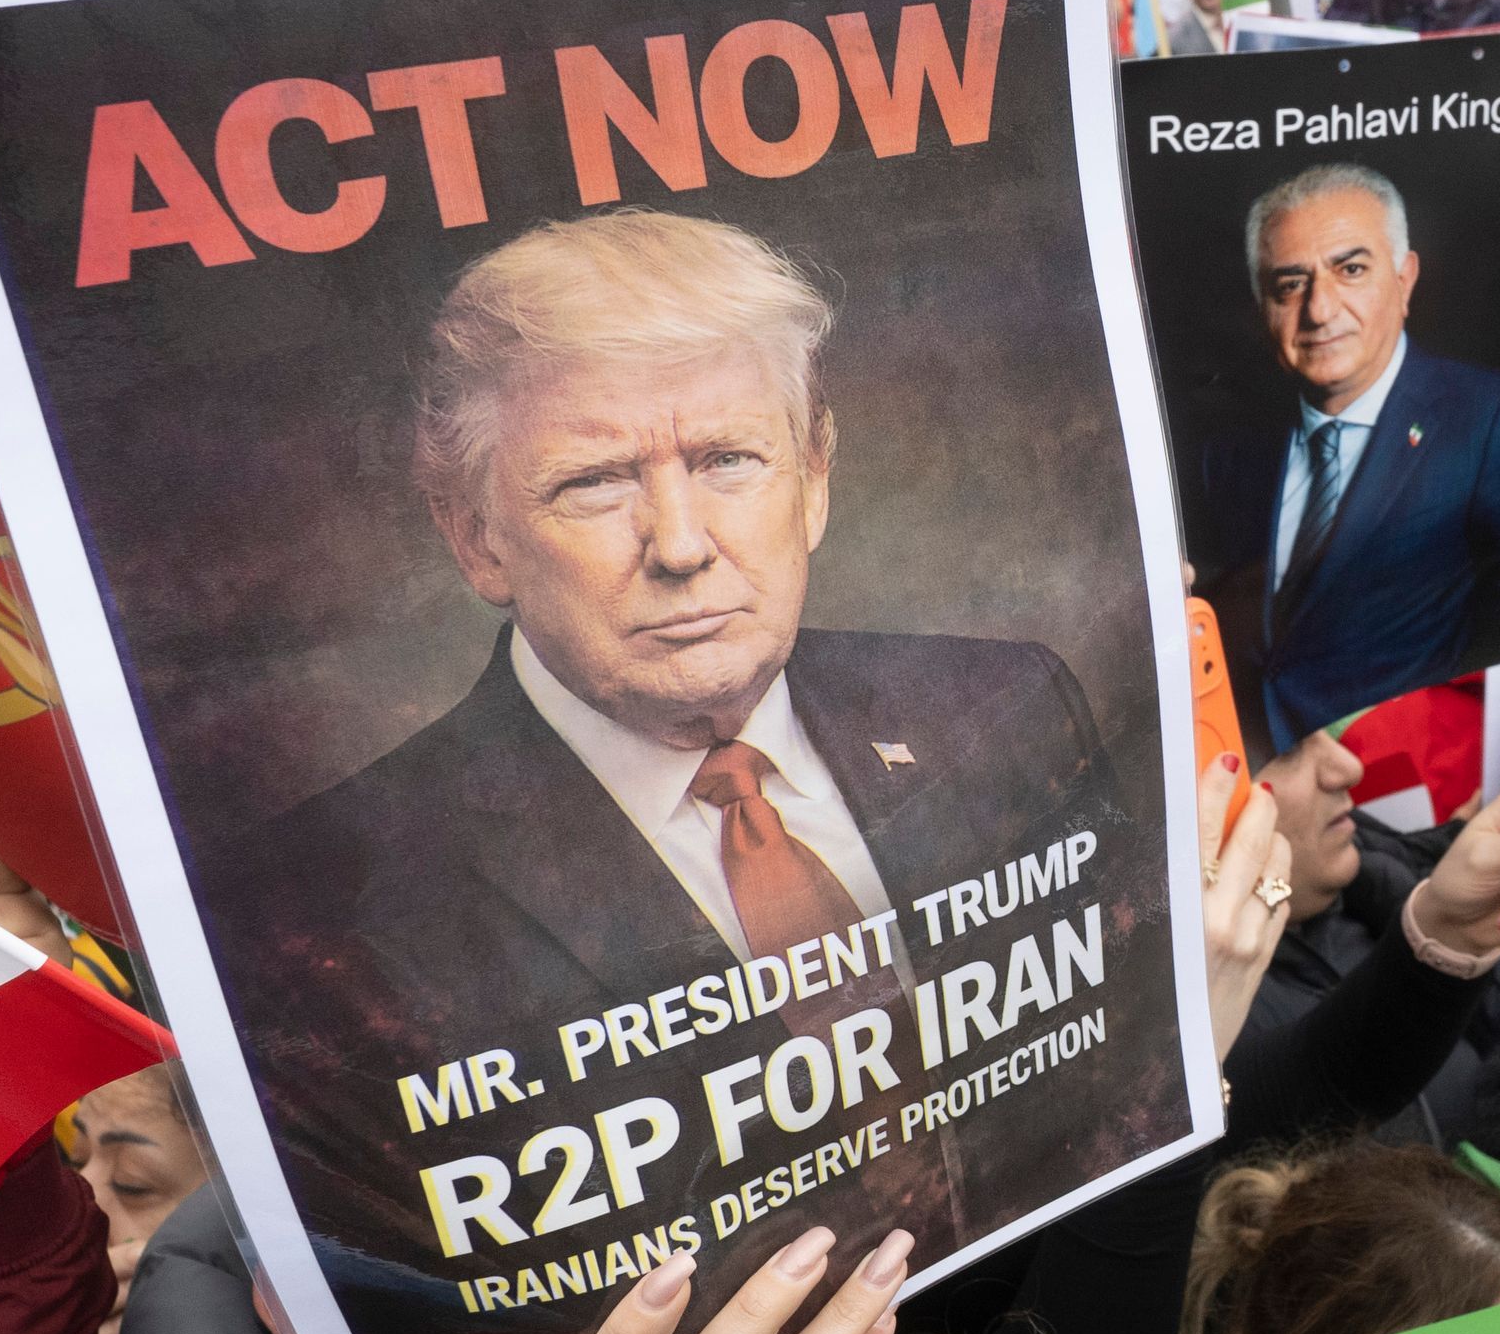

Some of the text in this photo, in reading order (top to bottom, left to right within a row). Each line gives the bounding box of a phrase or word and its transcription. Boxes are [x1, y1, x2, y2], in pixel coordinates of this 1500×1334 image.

[75, 56, 506, 288] ACT
[1148, 115, 1260, 154] Reza
[1275, 97, 1419, 146] Pahlavi
[397, 830, 1098, 1133] MR. PRESIDENT TRUMP
[420, 902, 1106, 1259] R2P FOR IRAN
[458, 1008, 1107, 1314] IRANIANS DESERVE PROTECTION
